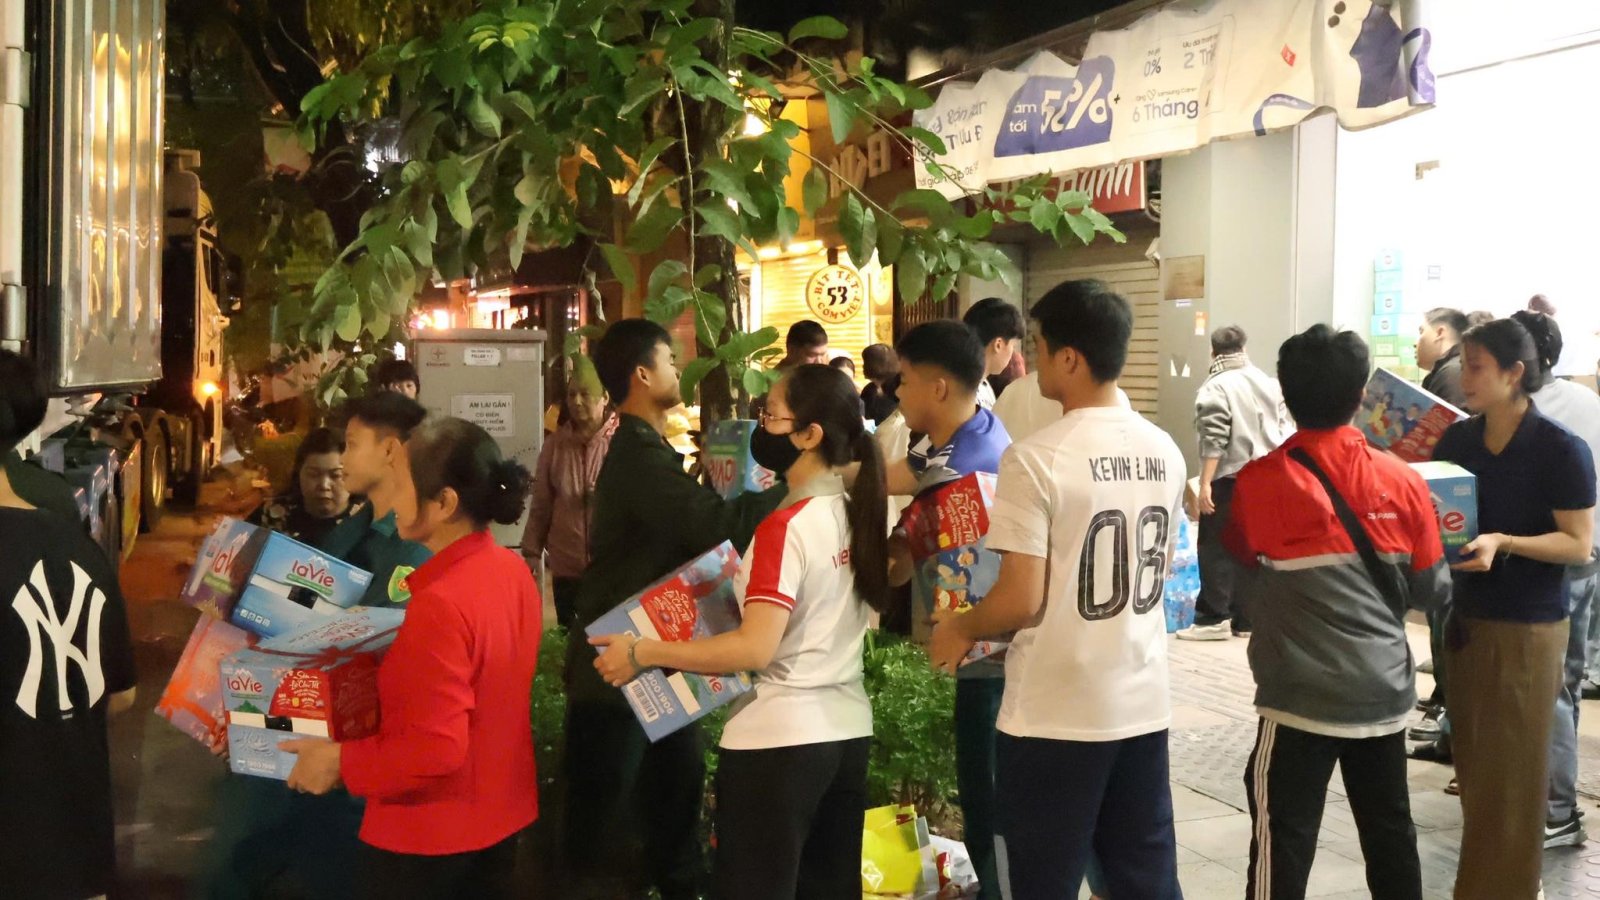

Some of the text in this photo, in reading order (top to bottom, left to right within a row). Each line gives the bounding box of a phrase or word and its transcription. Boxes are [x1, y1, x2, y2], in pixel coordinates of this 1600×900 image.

[1144, 57, 1161, 77] 0%
[1184, 52, 1195, 69] 2
[1144, 97, 1199, 119] Tháng
[1010, 119, 1027, 132] tới
[827, 286, 848, 306] 53
[1089, 456, 1166, 482] KEVIN LINH
[291, 559, 335, 587] laVie
[1077, 505, 1169, 621] 08
[12, 559, 106, 719] NY
[227, 676, 262, 693] laVie
